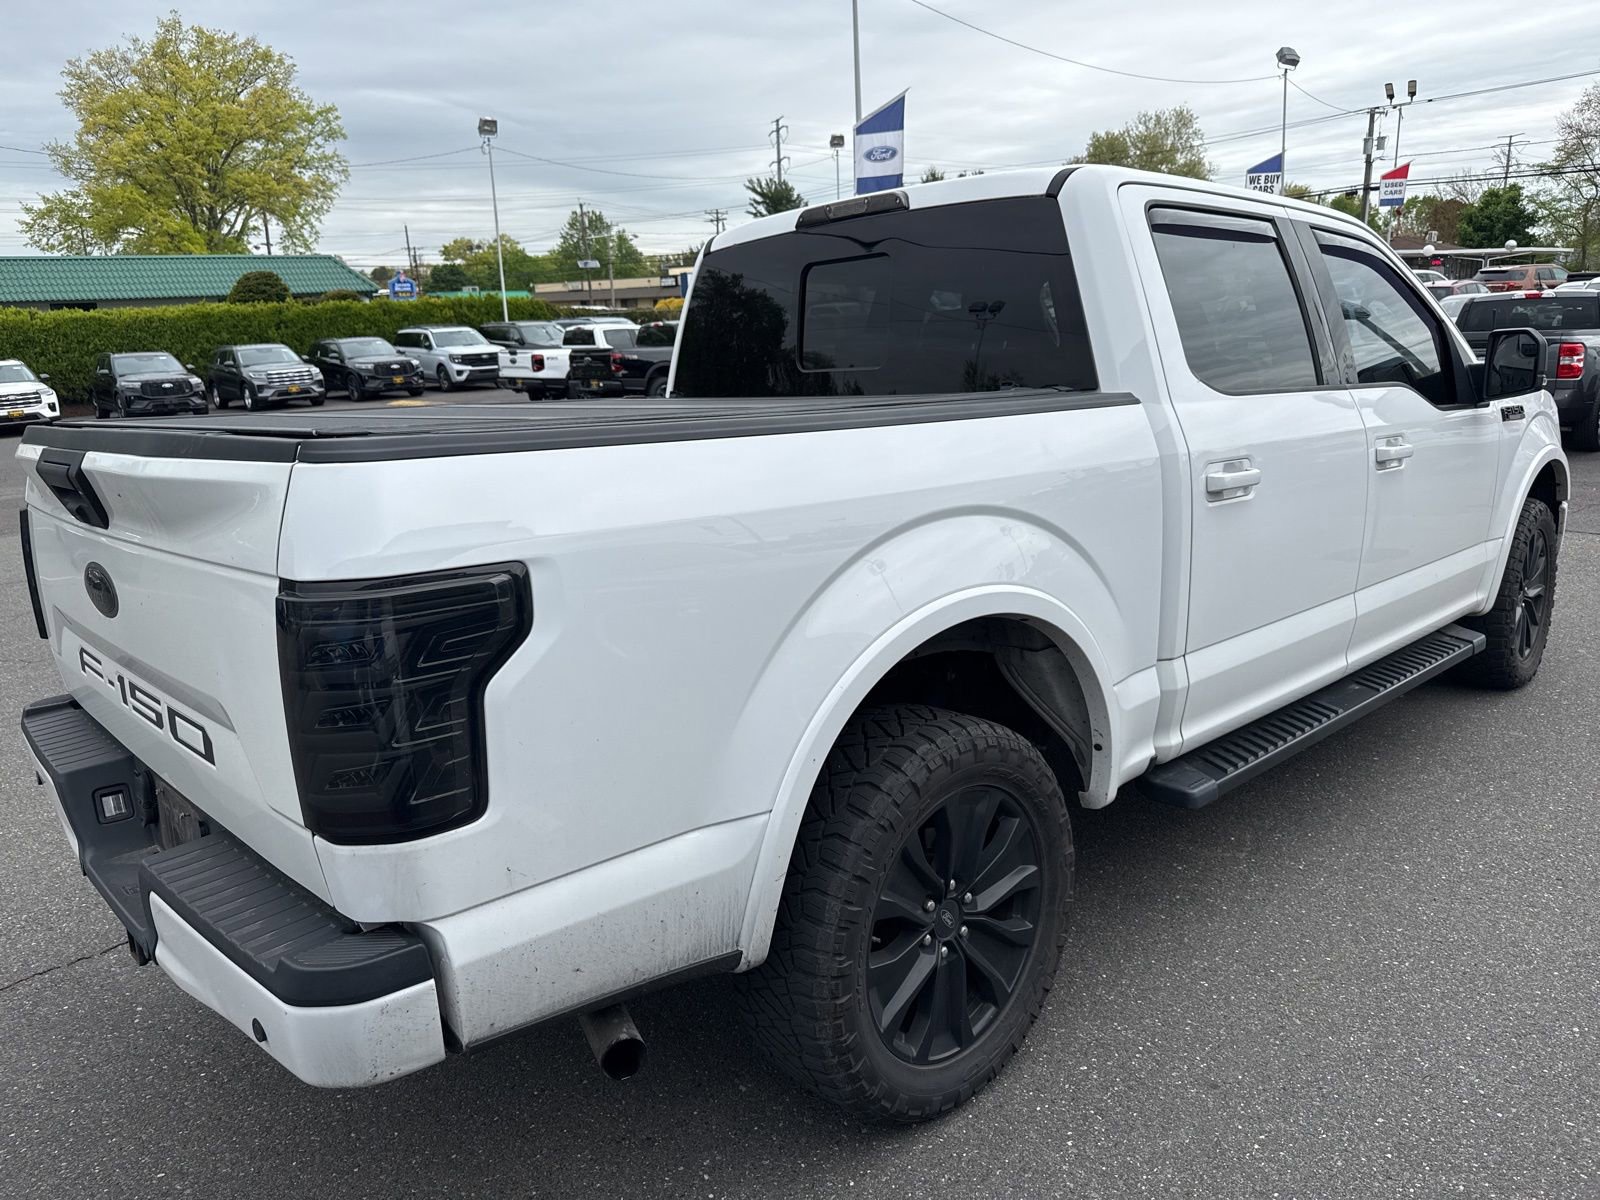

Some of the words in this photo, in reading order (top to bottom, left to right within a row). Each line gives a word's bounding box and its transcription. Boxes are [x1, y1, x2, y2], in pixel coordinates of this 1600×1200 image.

[870, 148, 893, 160] Ford
[1249, 175, 1262, 185] WE
[1264, 174, 1281, 185] BUY
[79, 647, 216, 767] F-150
